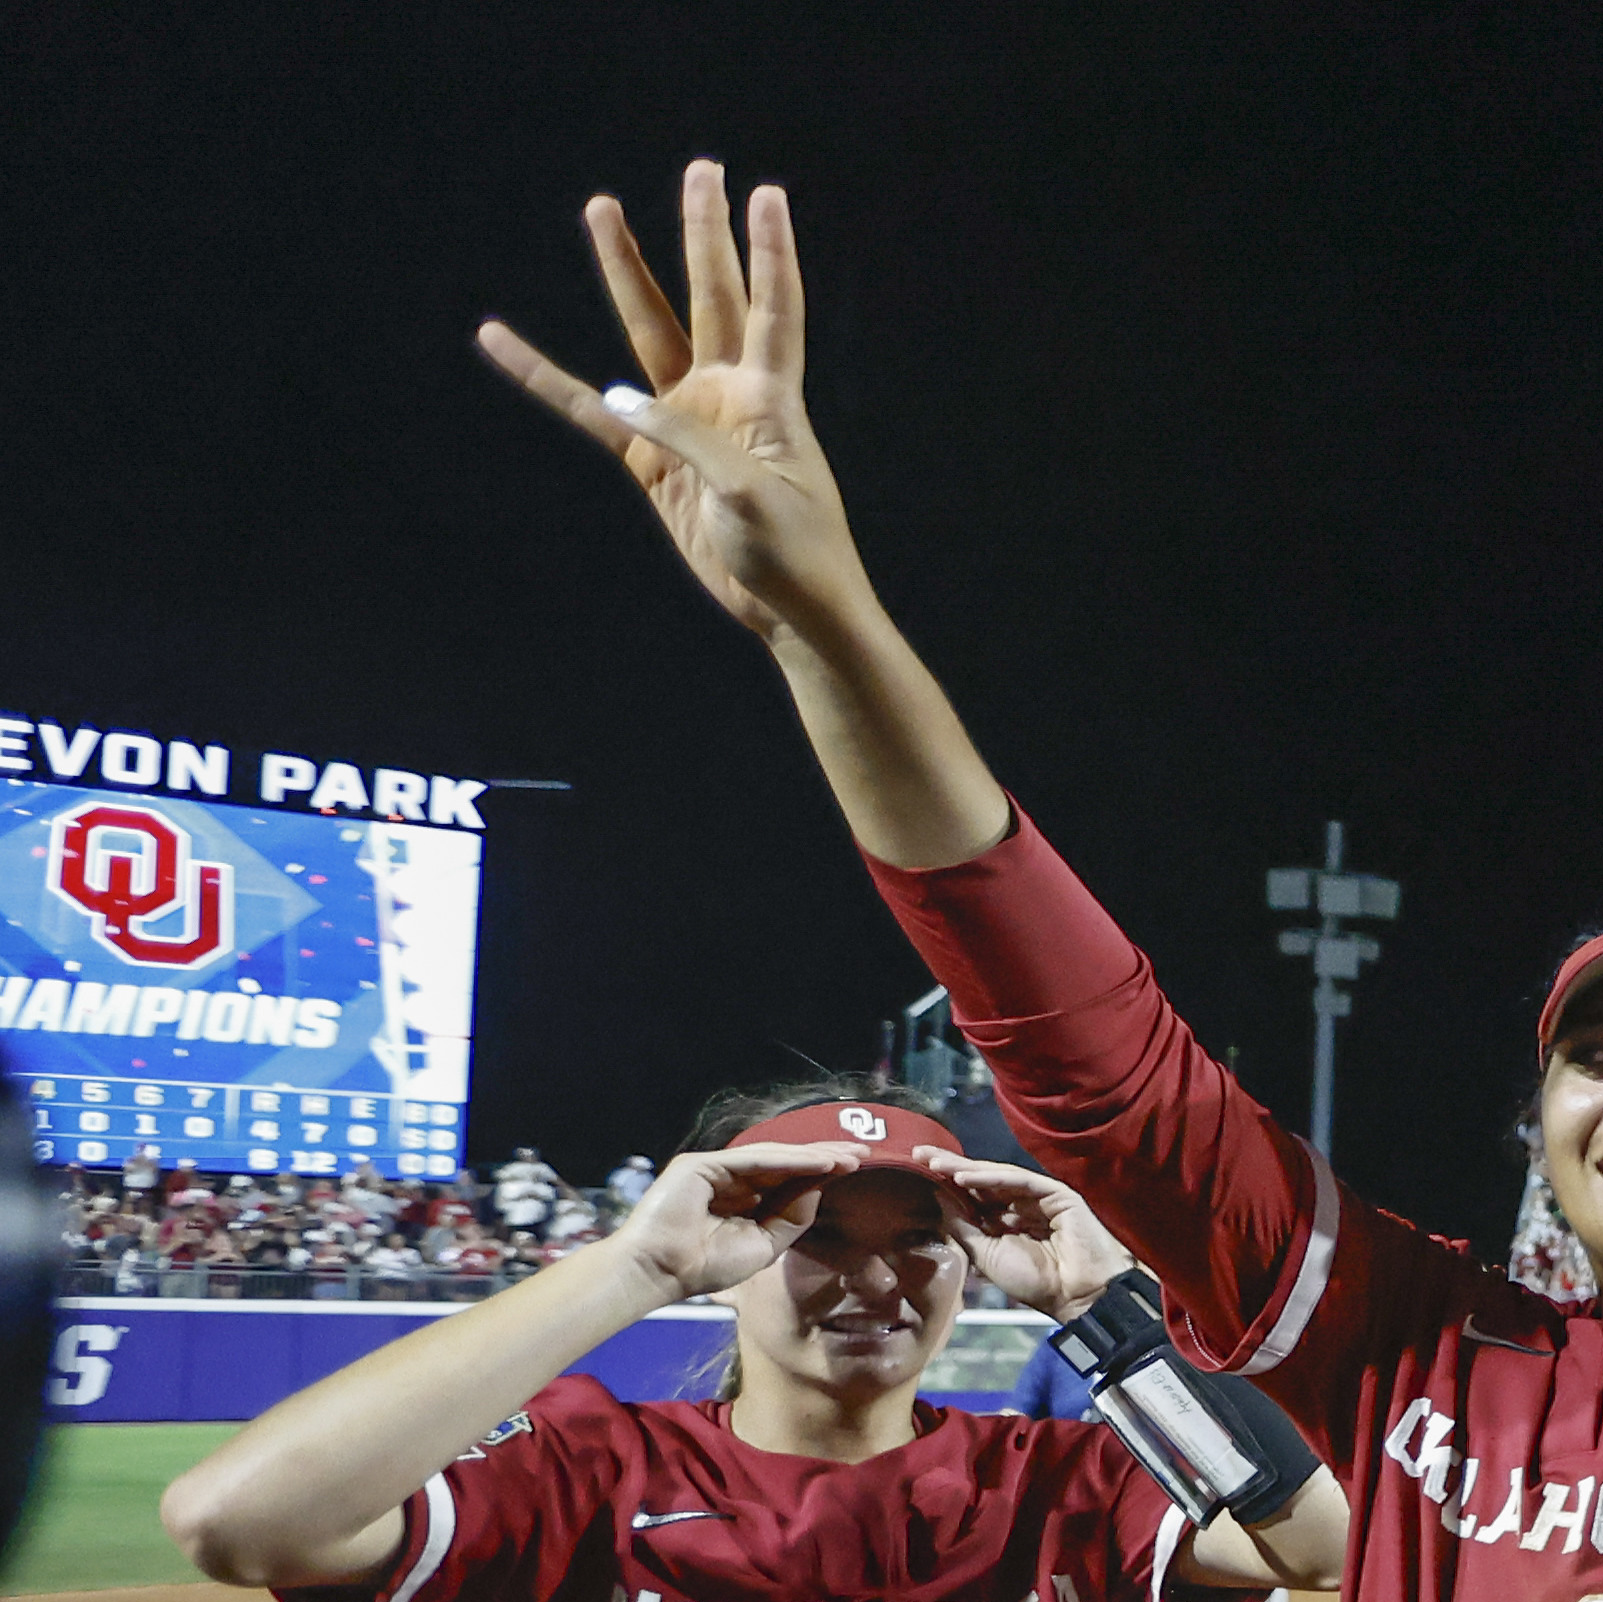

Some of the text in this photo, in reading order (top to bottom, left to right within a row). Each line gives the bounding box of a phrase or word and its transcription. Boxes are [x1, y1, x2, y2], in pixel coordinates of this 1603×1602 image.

[261, 752, 488, 829] PARK
[47, 801, 235, 970] OU
[81, 1081, 111, 1102] 5
[134, 1085, 165, 1106] 6
[187, 1088, 215, 1108] 7
[36, 1109, 53, 1129] 1
[79, 1111, 110, 1132] 0
[134, 1114, 160, 1135] 1
[183, 1116, 215, 1138] 0
[250, 1120, 281, 1141] 4
[301, 1122, 329, 1143] 7
[839, 1107, 887, 1140] OU
[78, 1140, 109, 1162] 0
